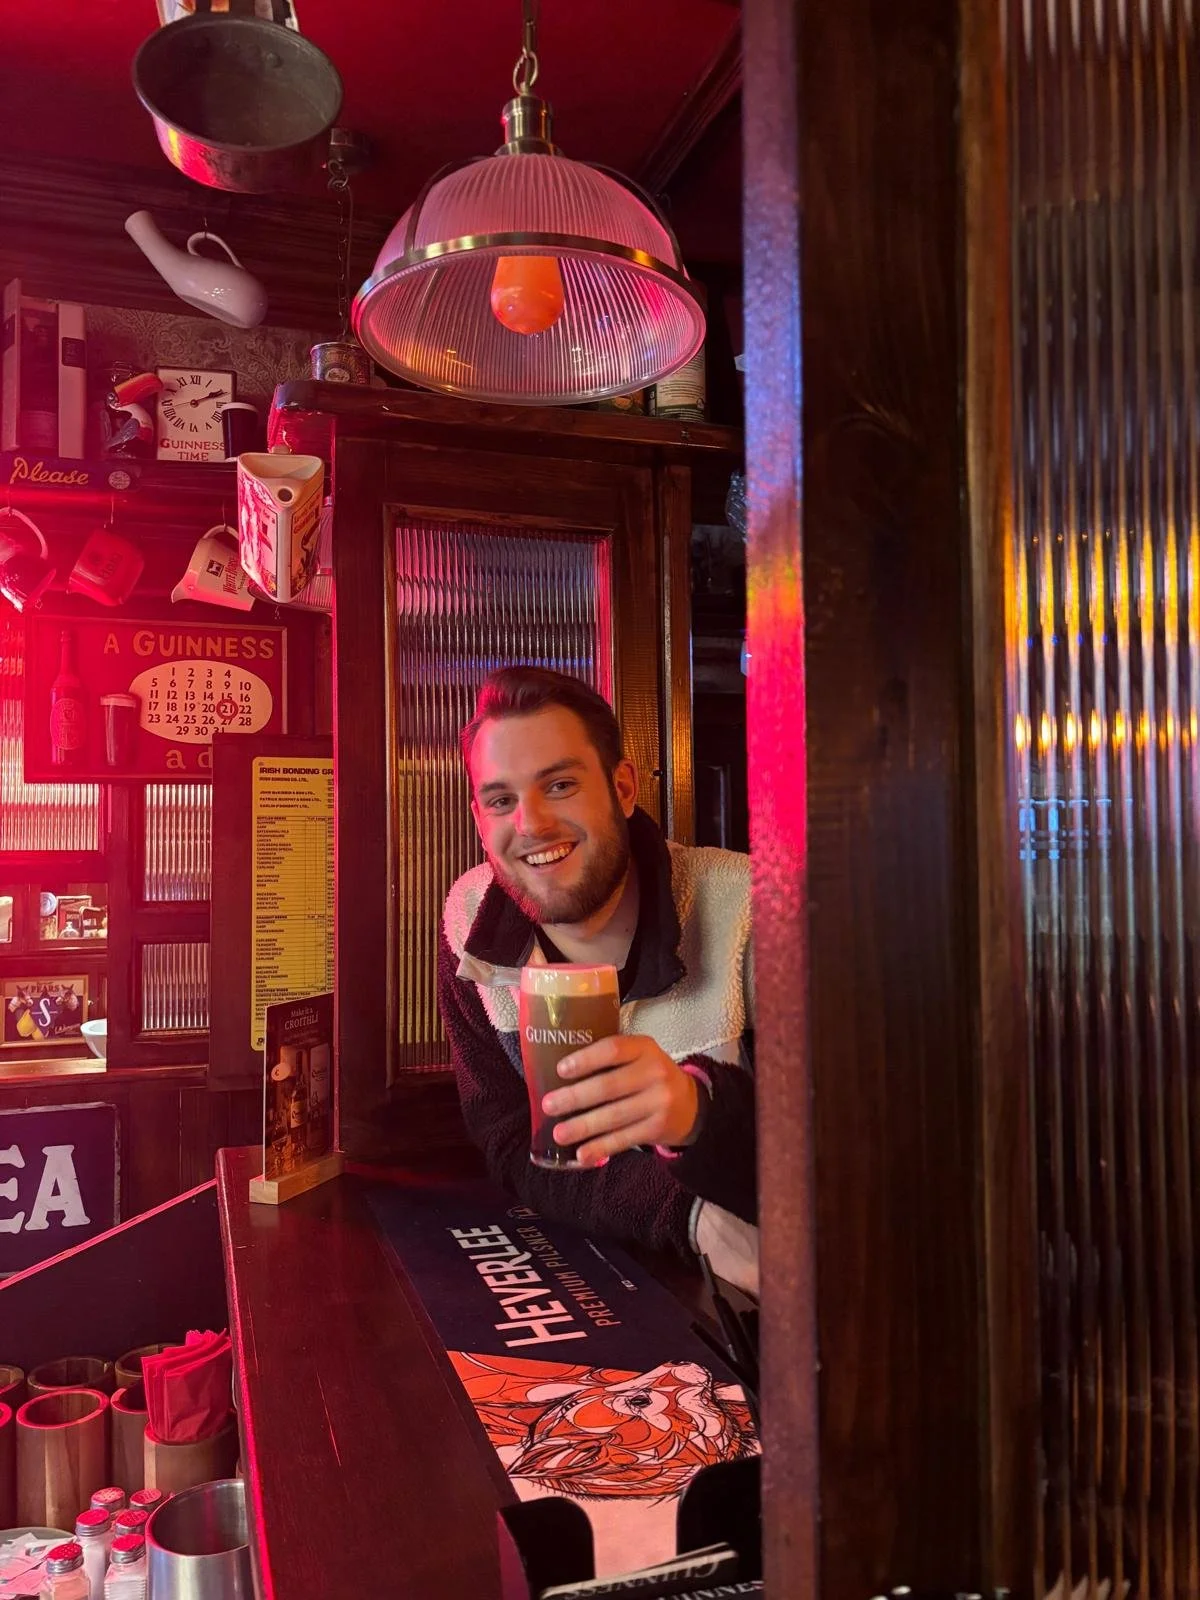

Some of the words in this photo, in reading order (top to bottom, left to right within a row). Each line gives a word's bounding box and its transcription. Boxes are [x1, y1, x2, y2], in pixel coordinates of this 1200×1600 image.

[160, 438, 225, 451] GUINNESS
[177, 451, 209, 462] TIME
[9, 456, 89, 486] Please
[103, 633, 120, 654] A
[133, 630, 275, 659] GUINNESS
[171, 668, 175, 676] 1
[187, 668, 195, 677] 2
[207, 669, 213, 678] 3
[224, 670, 232, 678] 4
[151, 678, 158, 687] 5
[169, 679, 176, 688] 6
[187, 679, 193, 689] 7
[206, 680, 213, 689] 8
[224, 681, 231, 690] 9
[239, 682, 251, 691] 10
[151, 690, 158, 698] 11
[166, 691, 178, 700] 12
[185, 691, 195, 701] 13
[203, 692, 214, 701] 14
[222, 693, 233, 702] 15
[240, 693, 251, 702] 16
[148, 702, 158, 711] 17
[166, 702, 177, 712] 18
[184, 703, 195, 712] 19
[202, 704, 216, 713] 20
[222, 704, 233, 714] 21
[238, 705, 252, 715] 22
[148, 714, 161, 723] 23
[166, 715, 179, 724] 24
[183, 715, 197, 724] 25
[201, 715, 215, 725] 26
[220, 716, 233, 726] 27
[238, 717, 252, 726] 28
[176, 726, 189, 735] 29
[194, 726, 208, 736] 30
[165, 749, 186, 770] a
[259, 767, 281, 775] IRISH
[282, 767, 320, 775] BONDING
[525, 1025, 593, 1045] GUINNESS
[516, 1226, 569, 1269] PILSNER
[449, 1224, 588, 1348] HEVERLEE
[554, 1271, 623, 1328] PREMIUM
